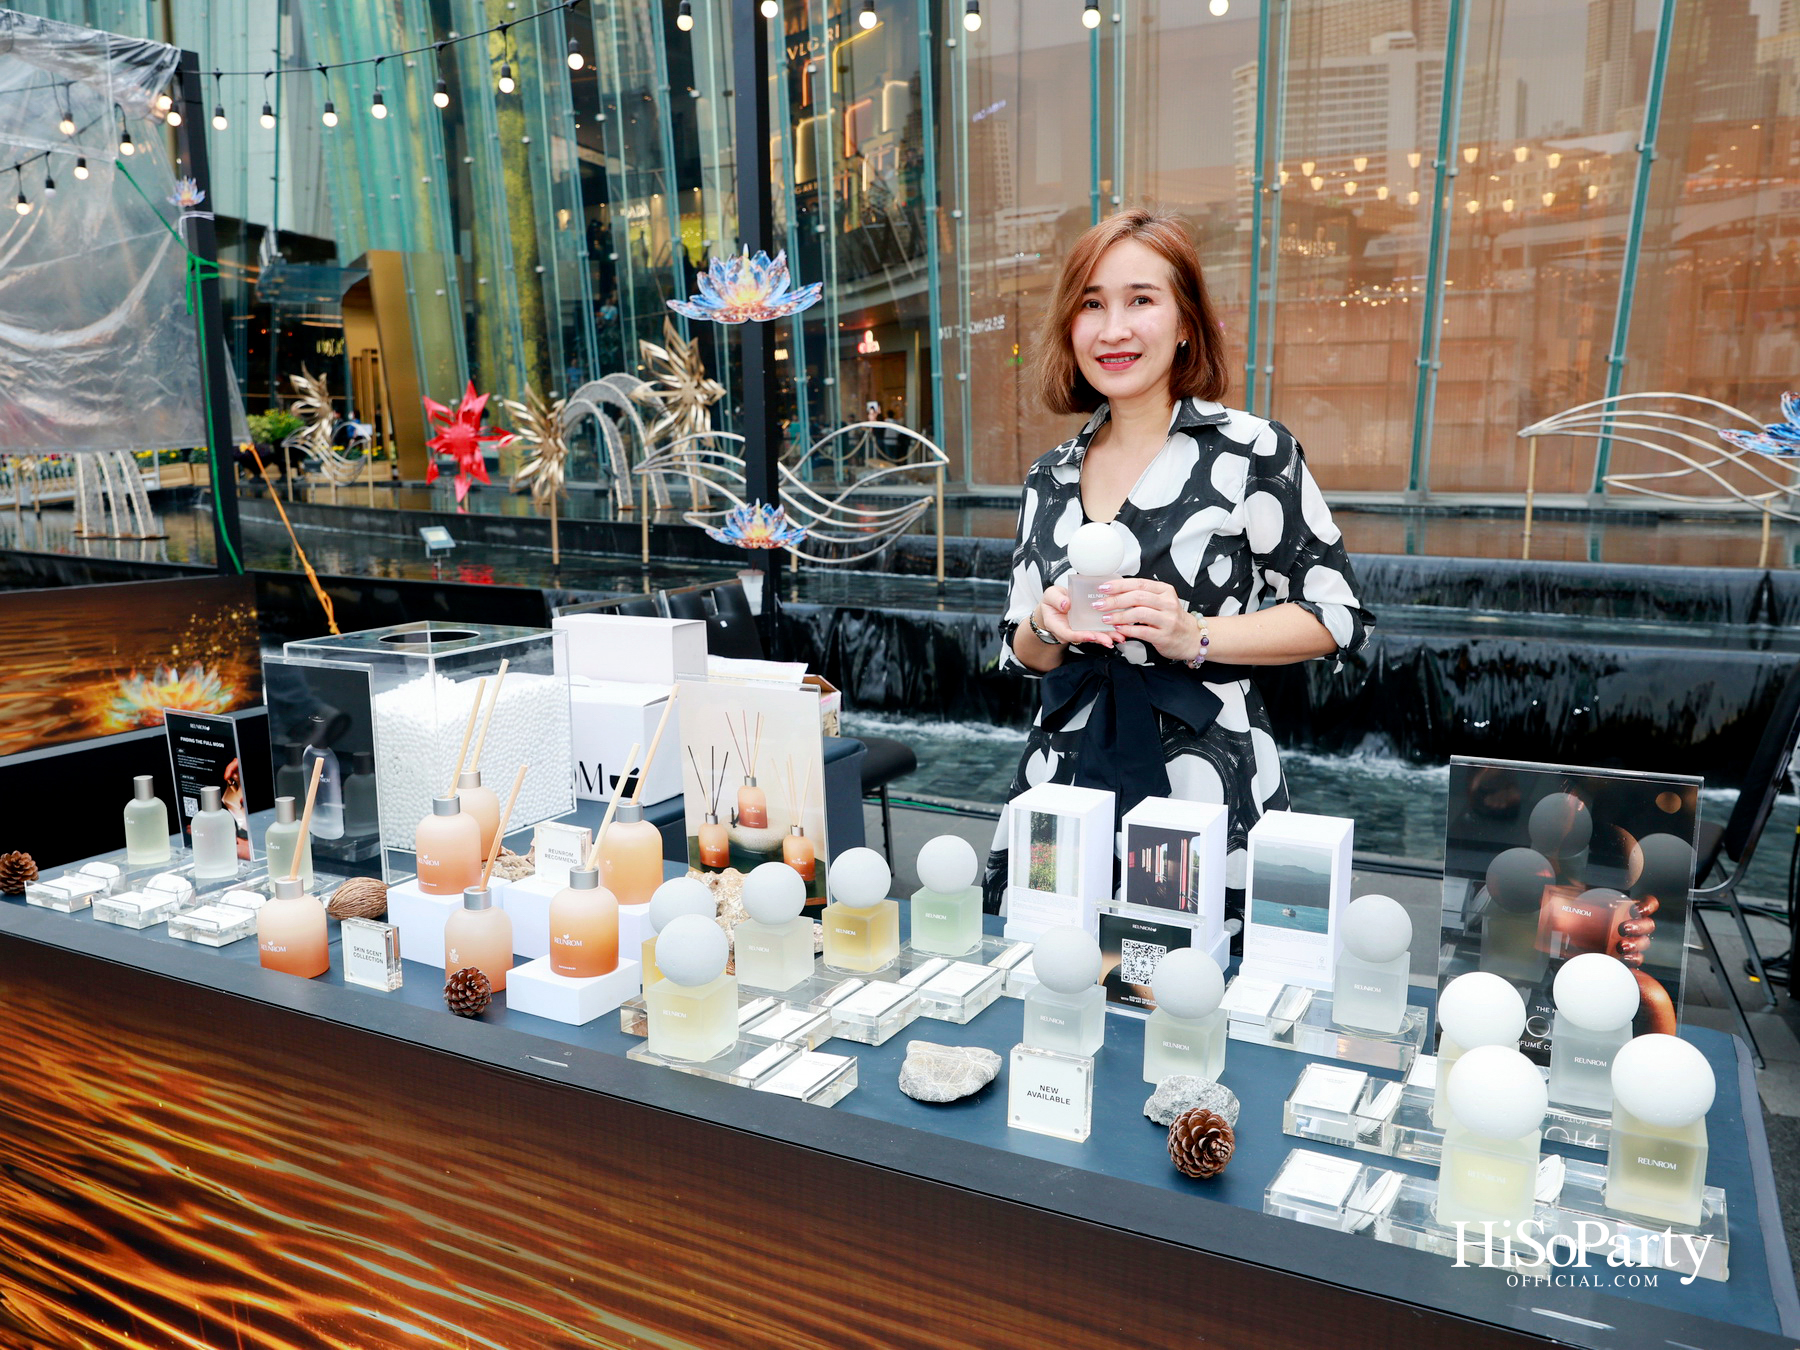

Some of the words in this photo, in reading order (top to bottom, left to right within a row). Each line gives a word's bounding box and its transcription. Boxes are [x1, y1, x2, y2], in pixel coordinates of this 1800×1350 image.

[548, 848, 574, 857] REUNROM
[544, 853, 578, 864] RECOMMEND
[1562, 905, 1592, 917] REUNROM
[353, 951, 384, 964] COLLECTION
[366, 949, 382, 957] SCENT
[1354, 983, 1382, 993] REUNROM
[1536, 1005, 1550, 1013] THE
[1162, 1040, 1190, 1051] REUNROM
[1574, 1056, 1607, 1067] REUNROM
[1039, 1084, 1059, 1094] NEW
[1026, 1090, 1071, 1105] AVAILABLE
[1637, 1156, 1677, 1171] REUNROM
